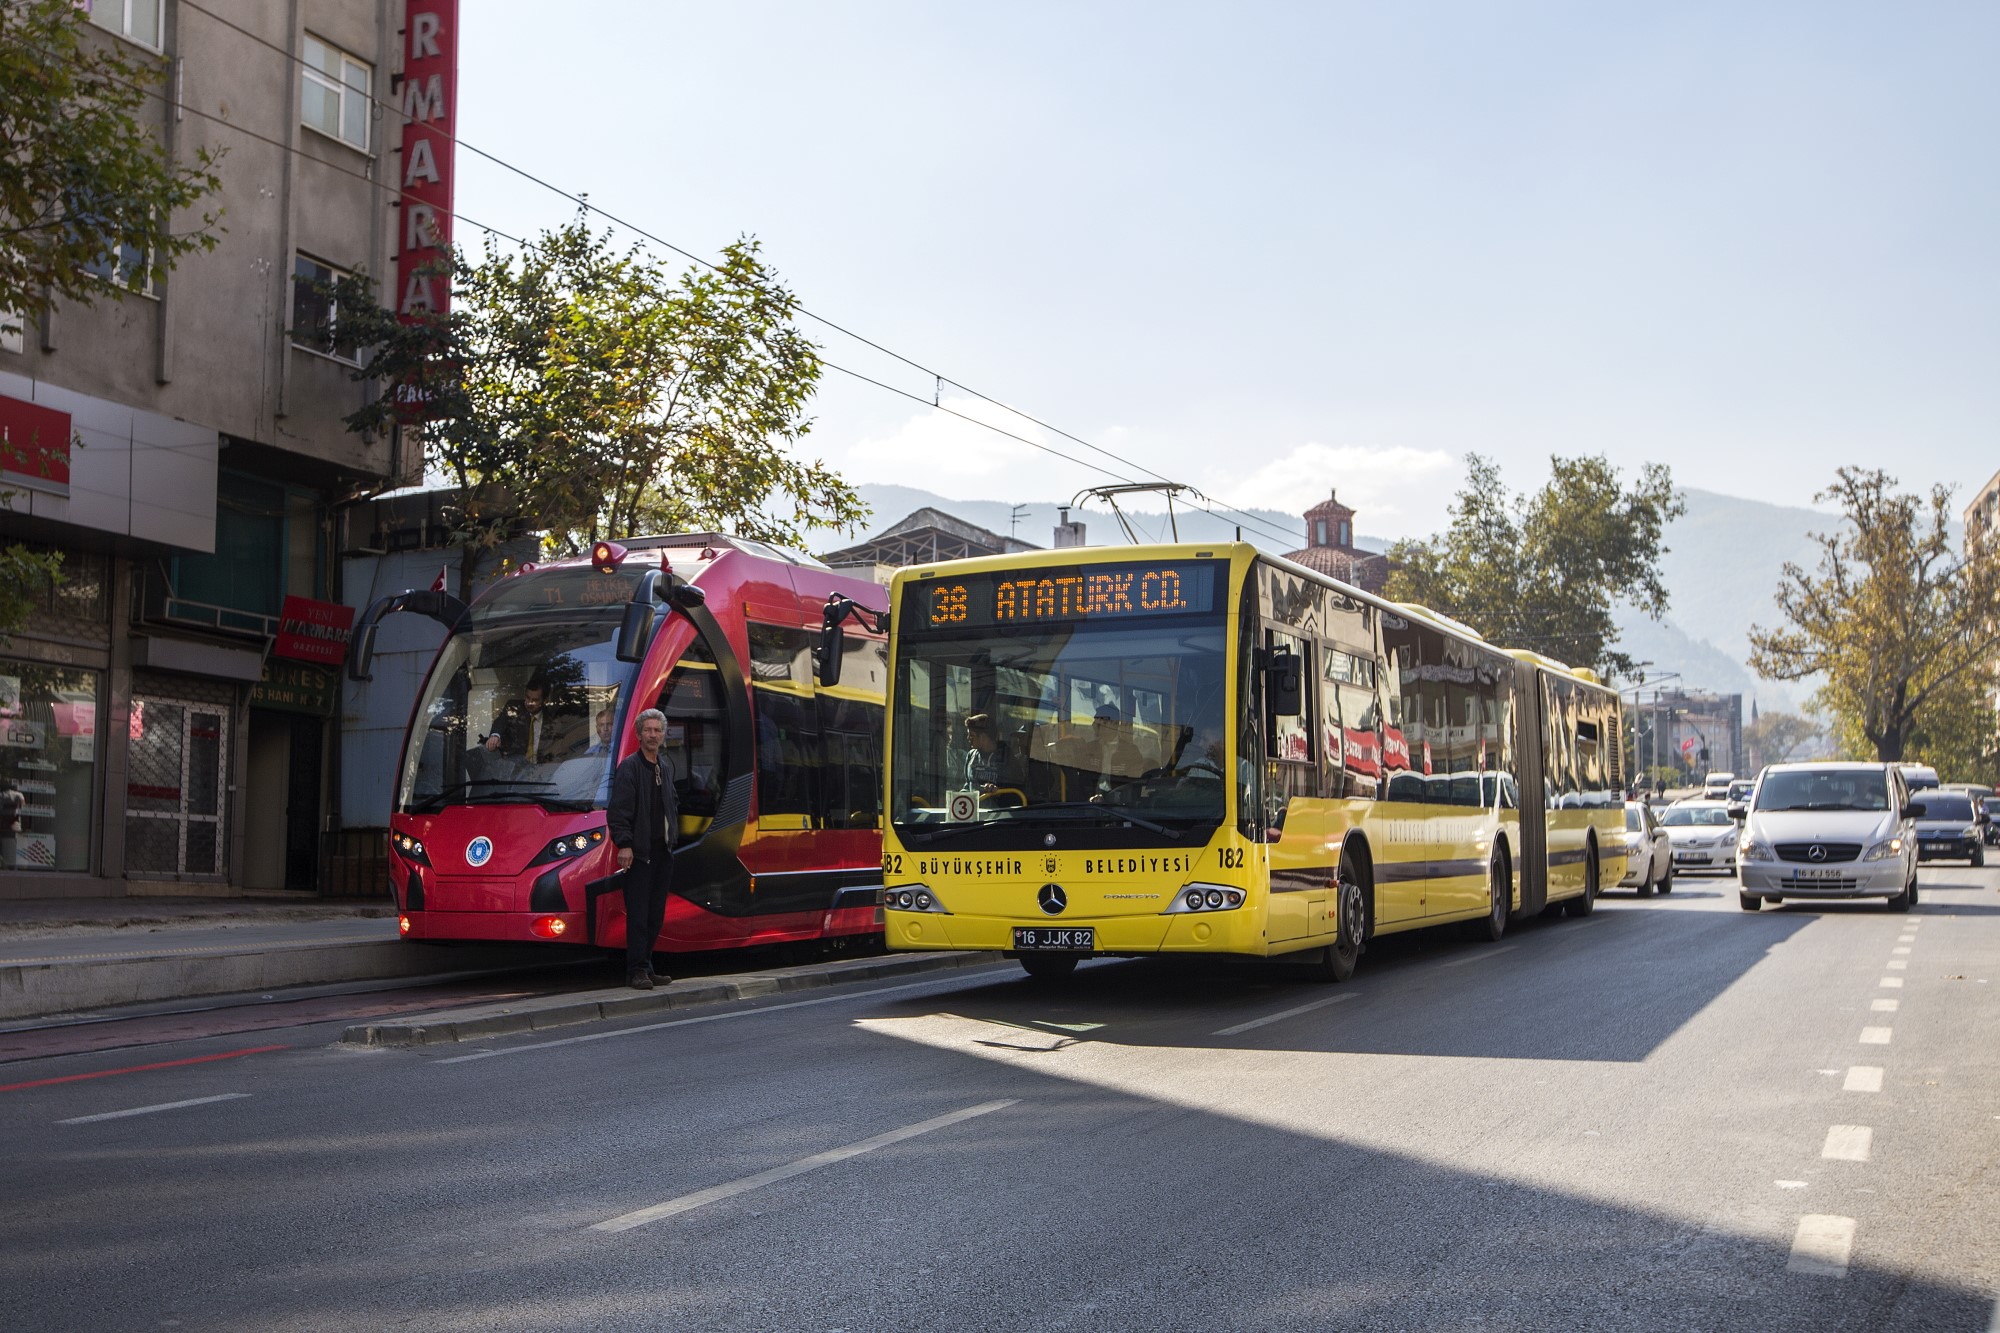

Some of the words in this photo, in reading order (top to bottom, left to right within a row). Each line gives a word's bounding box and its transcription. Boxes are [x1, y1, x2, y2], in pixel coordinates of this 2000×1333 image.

[544, 587, 564, 604] T1
[931, 586, 968, 623] 38
[1141, 570, 1187, 609] CD.
[7, 730, 35, 743] LED
[958, 801, 968, 815] 3
[920, 857, 1022, 877] BÜYÜKŞEHİR
[1086, 855, 1190, 873] BELEDİYESİ
[1218, 848, 1244, 869] 182
[1022, 931, 1036, 944] 16
[1043, 931, 1071, 945] JJK
[1074, 932, 1091, 945] 82
